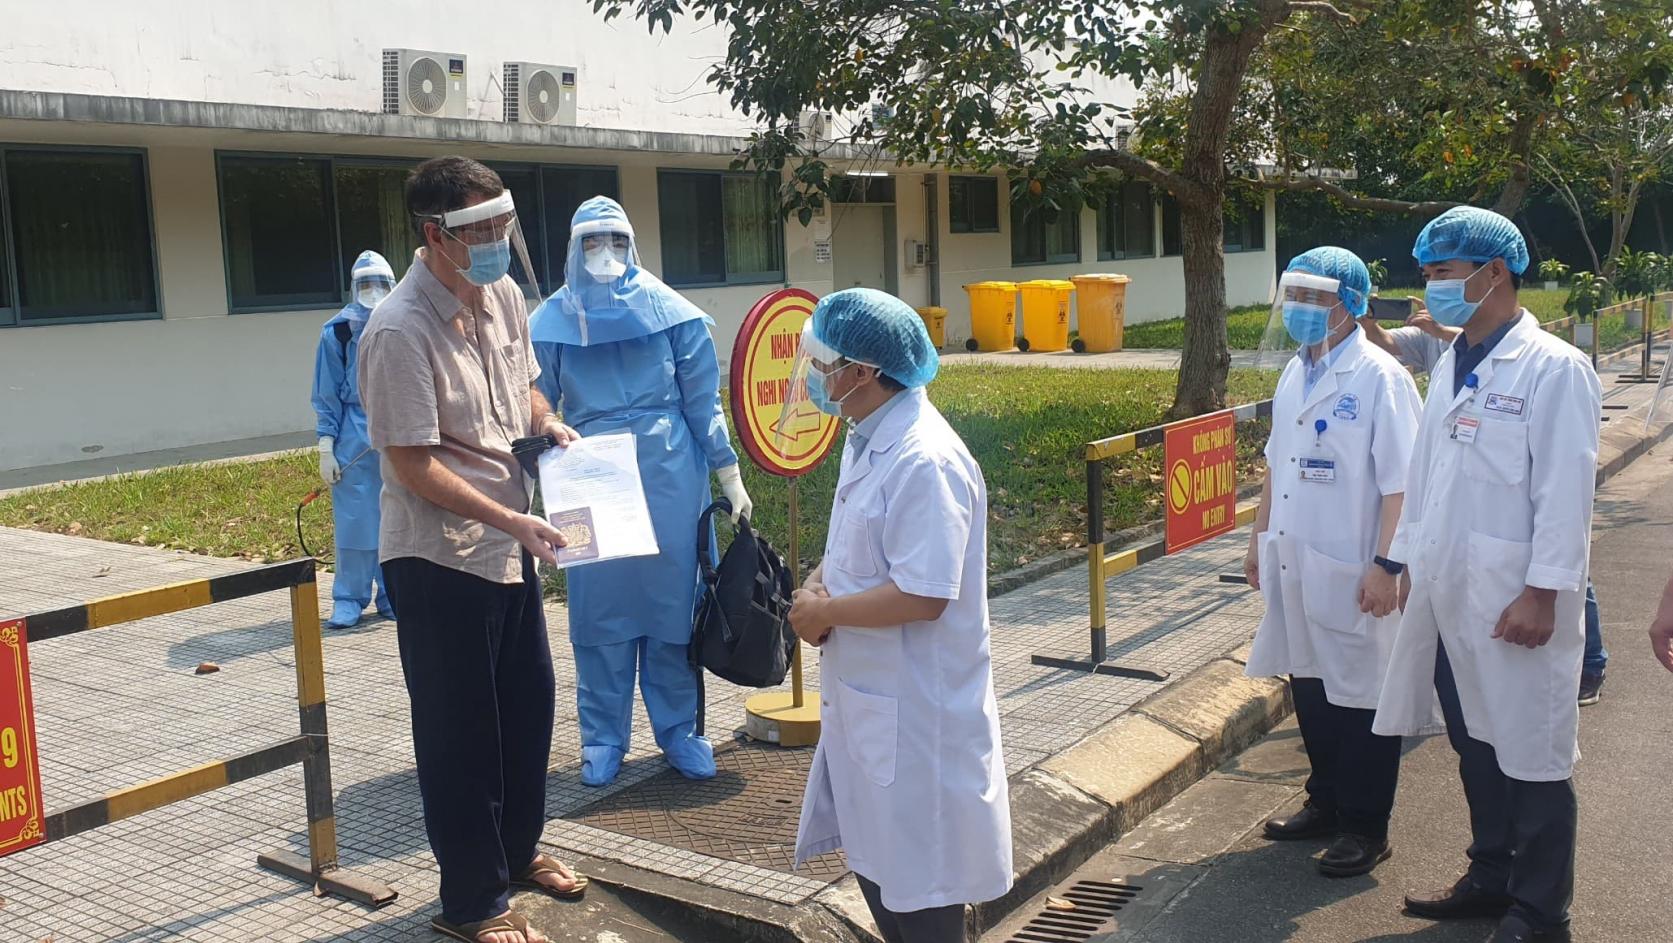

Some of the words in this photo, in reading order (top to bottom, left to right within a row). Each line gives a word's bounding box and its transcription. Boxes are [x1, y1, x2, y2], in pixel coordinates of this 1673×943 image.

[757, 378, 777, 406] NGHI
[1194, 455, 1214, 504] CẤM
[1215, 455, 1233, 497] VÀO
[1202, 510, 1210, 531] NO
[0, 785, 27, 822] NTS
